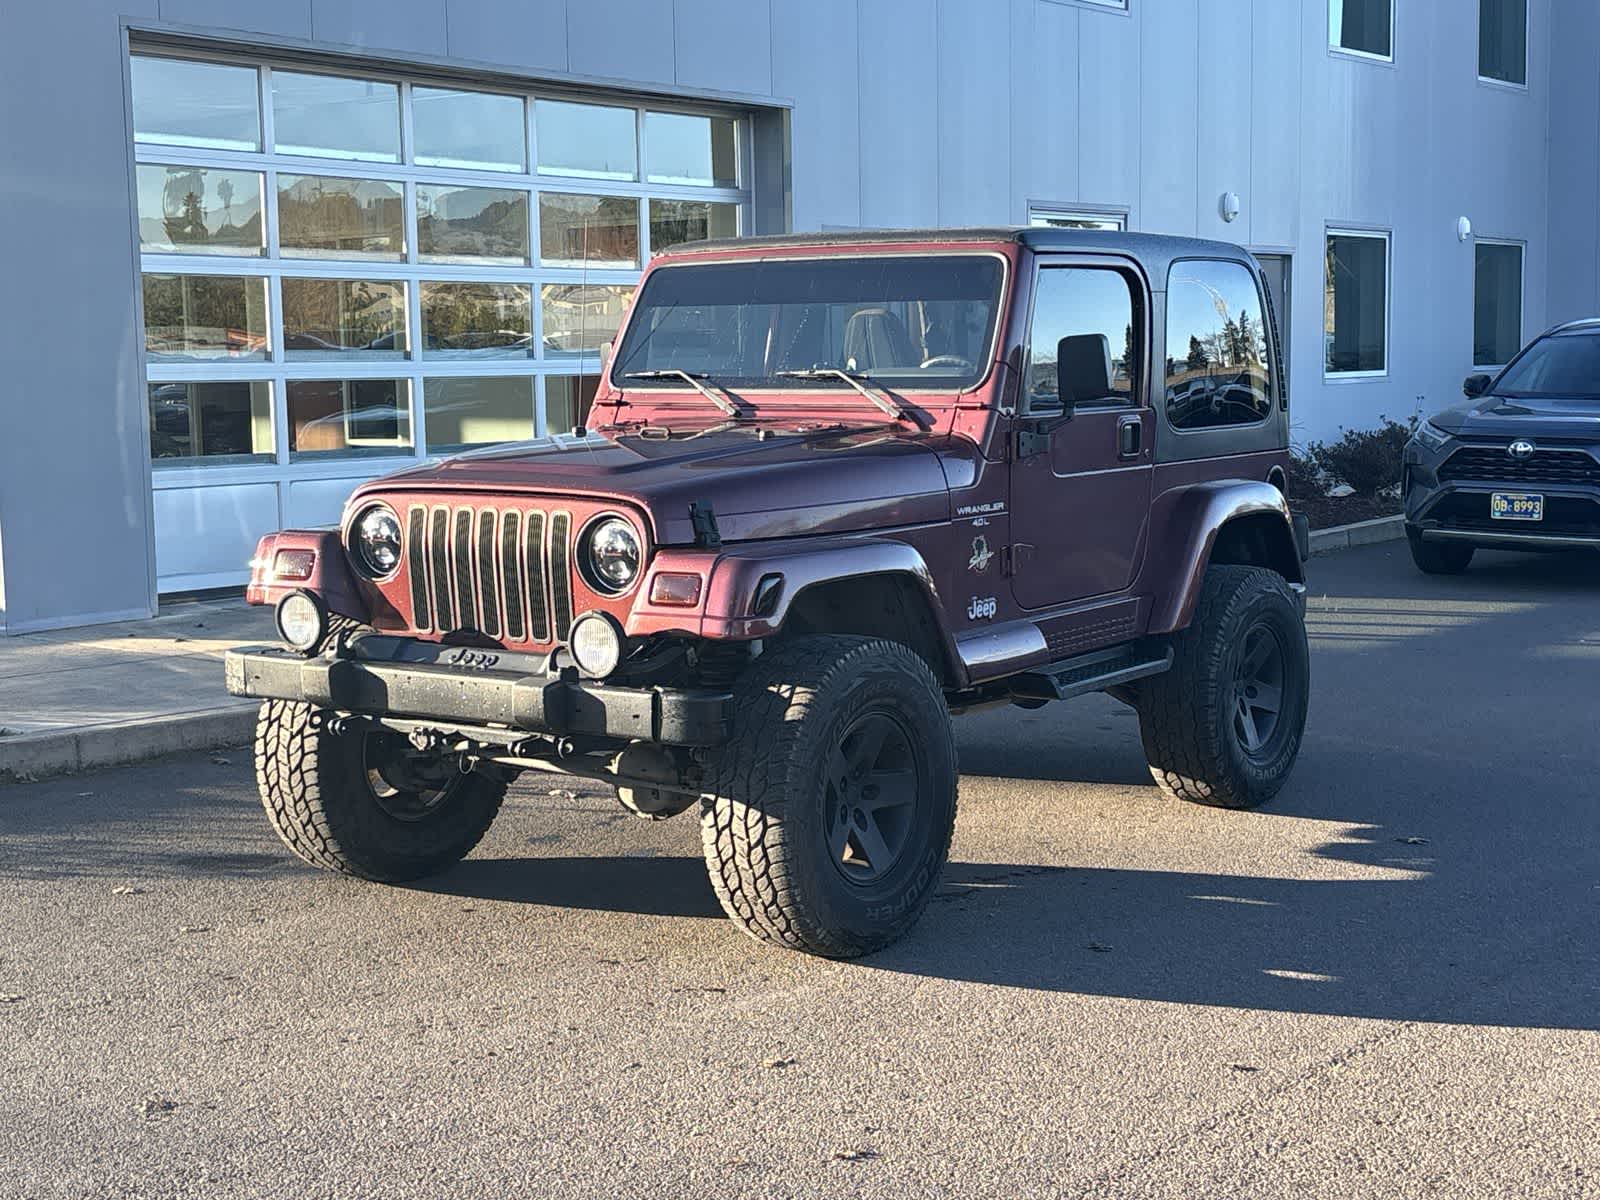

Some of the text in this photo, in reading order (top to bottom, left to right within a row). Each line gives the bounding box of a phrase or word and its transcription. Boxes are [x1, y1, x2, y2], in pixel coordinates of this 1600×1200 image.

[956, 502, 1005, 516] WRANGLER
[968, 596, 998, 621] Jeep
[865, 848, 937, 921] COOPER
